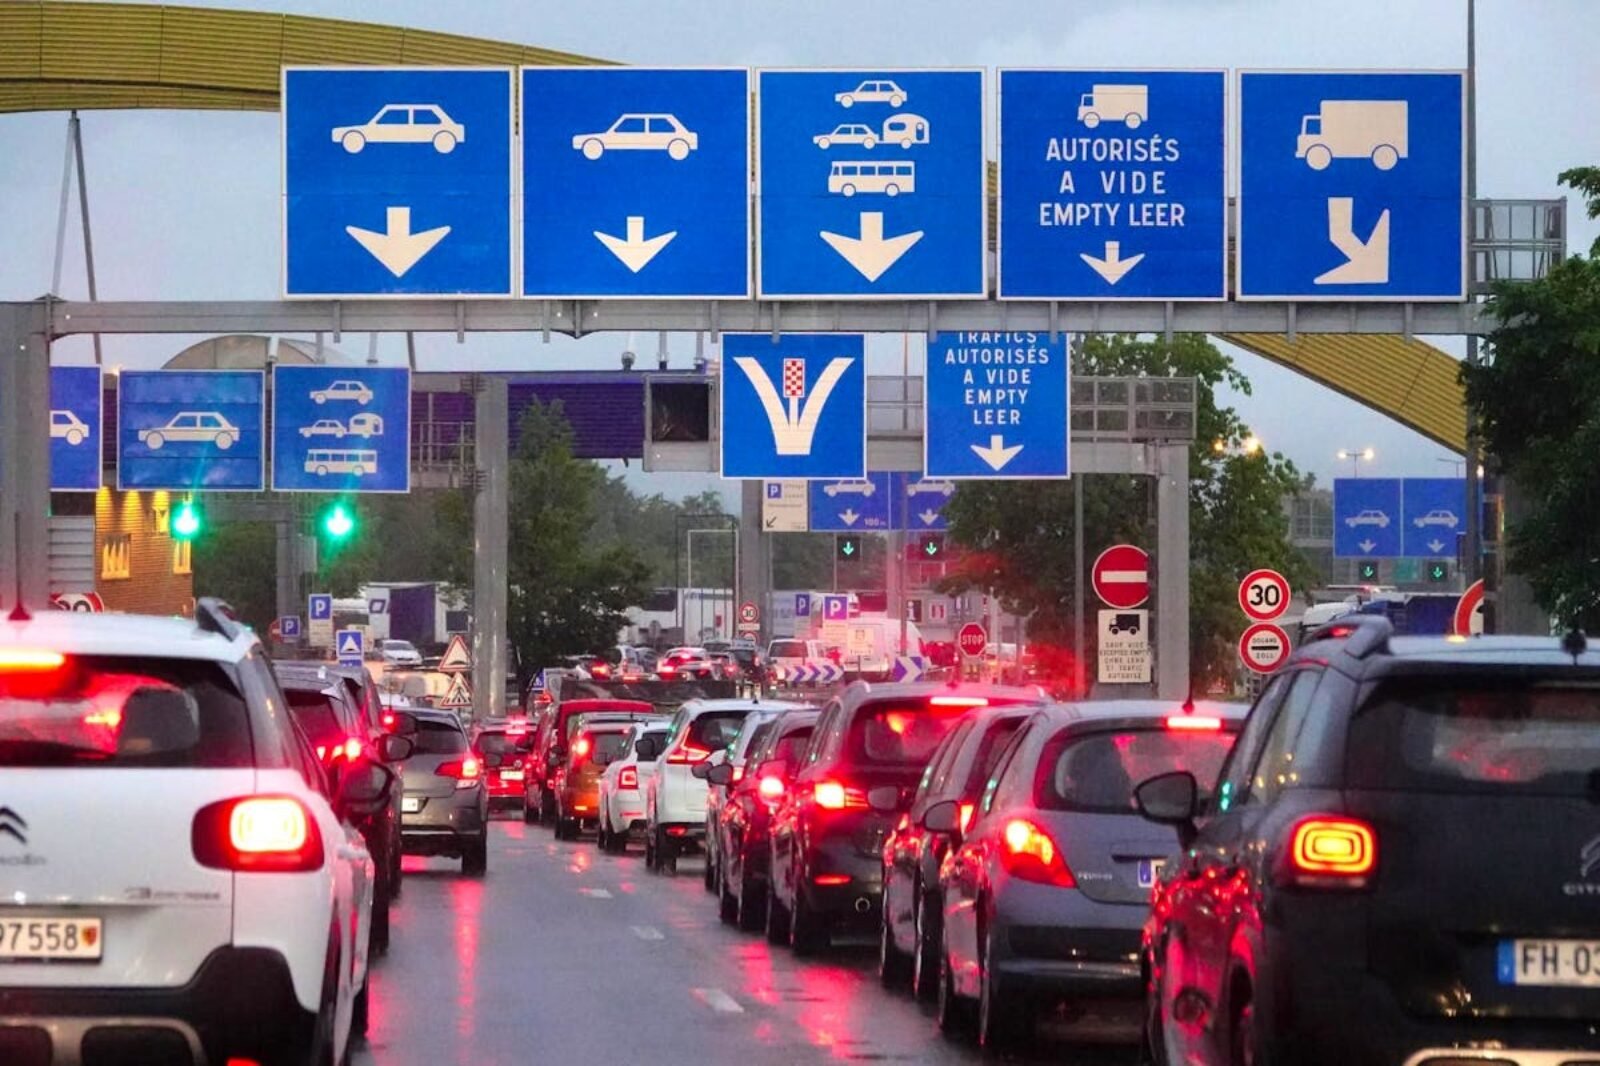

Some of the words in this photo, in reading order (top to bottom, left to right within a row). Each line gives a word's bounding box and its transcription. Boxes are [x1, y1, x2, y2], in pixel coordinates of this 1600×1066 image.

[1046, 134, 1180, 162] AUTORISÉS
[1059, 171, 1075, 194] A
[1101, 171, 1166, 194] VIDE
[1040, 203, 1120, 227] EMPTY
[1129, 203, 1185, 227] LEER
[945, 345, 1050, 365] AUTORISÉS
[963, 369, 974, 385] A
[986, 369, 1032, 385] VIDE
[965, 389, 1028, 405] EMPTY
[973, 409, 1021, 425] LEER
[1249, 584, 1280, 606] 30
[315, 599, 327, 617] P
[830, 600, 841, 617] P
[962, 634, 984, 646] STOP
